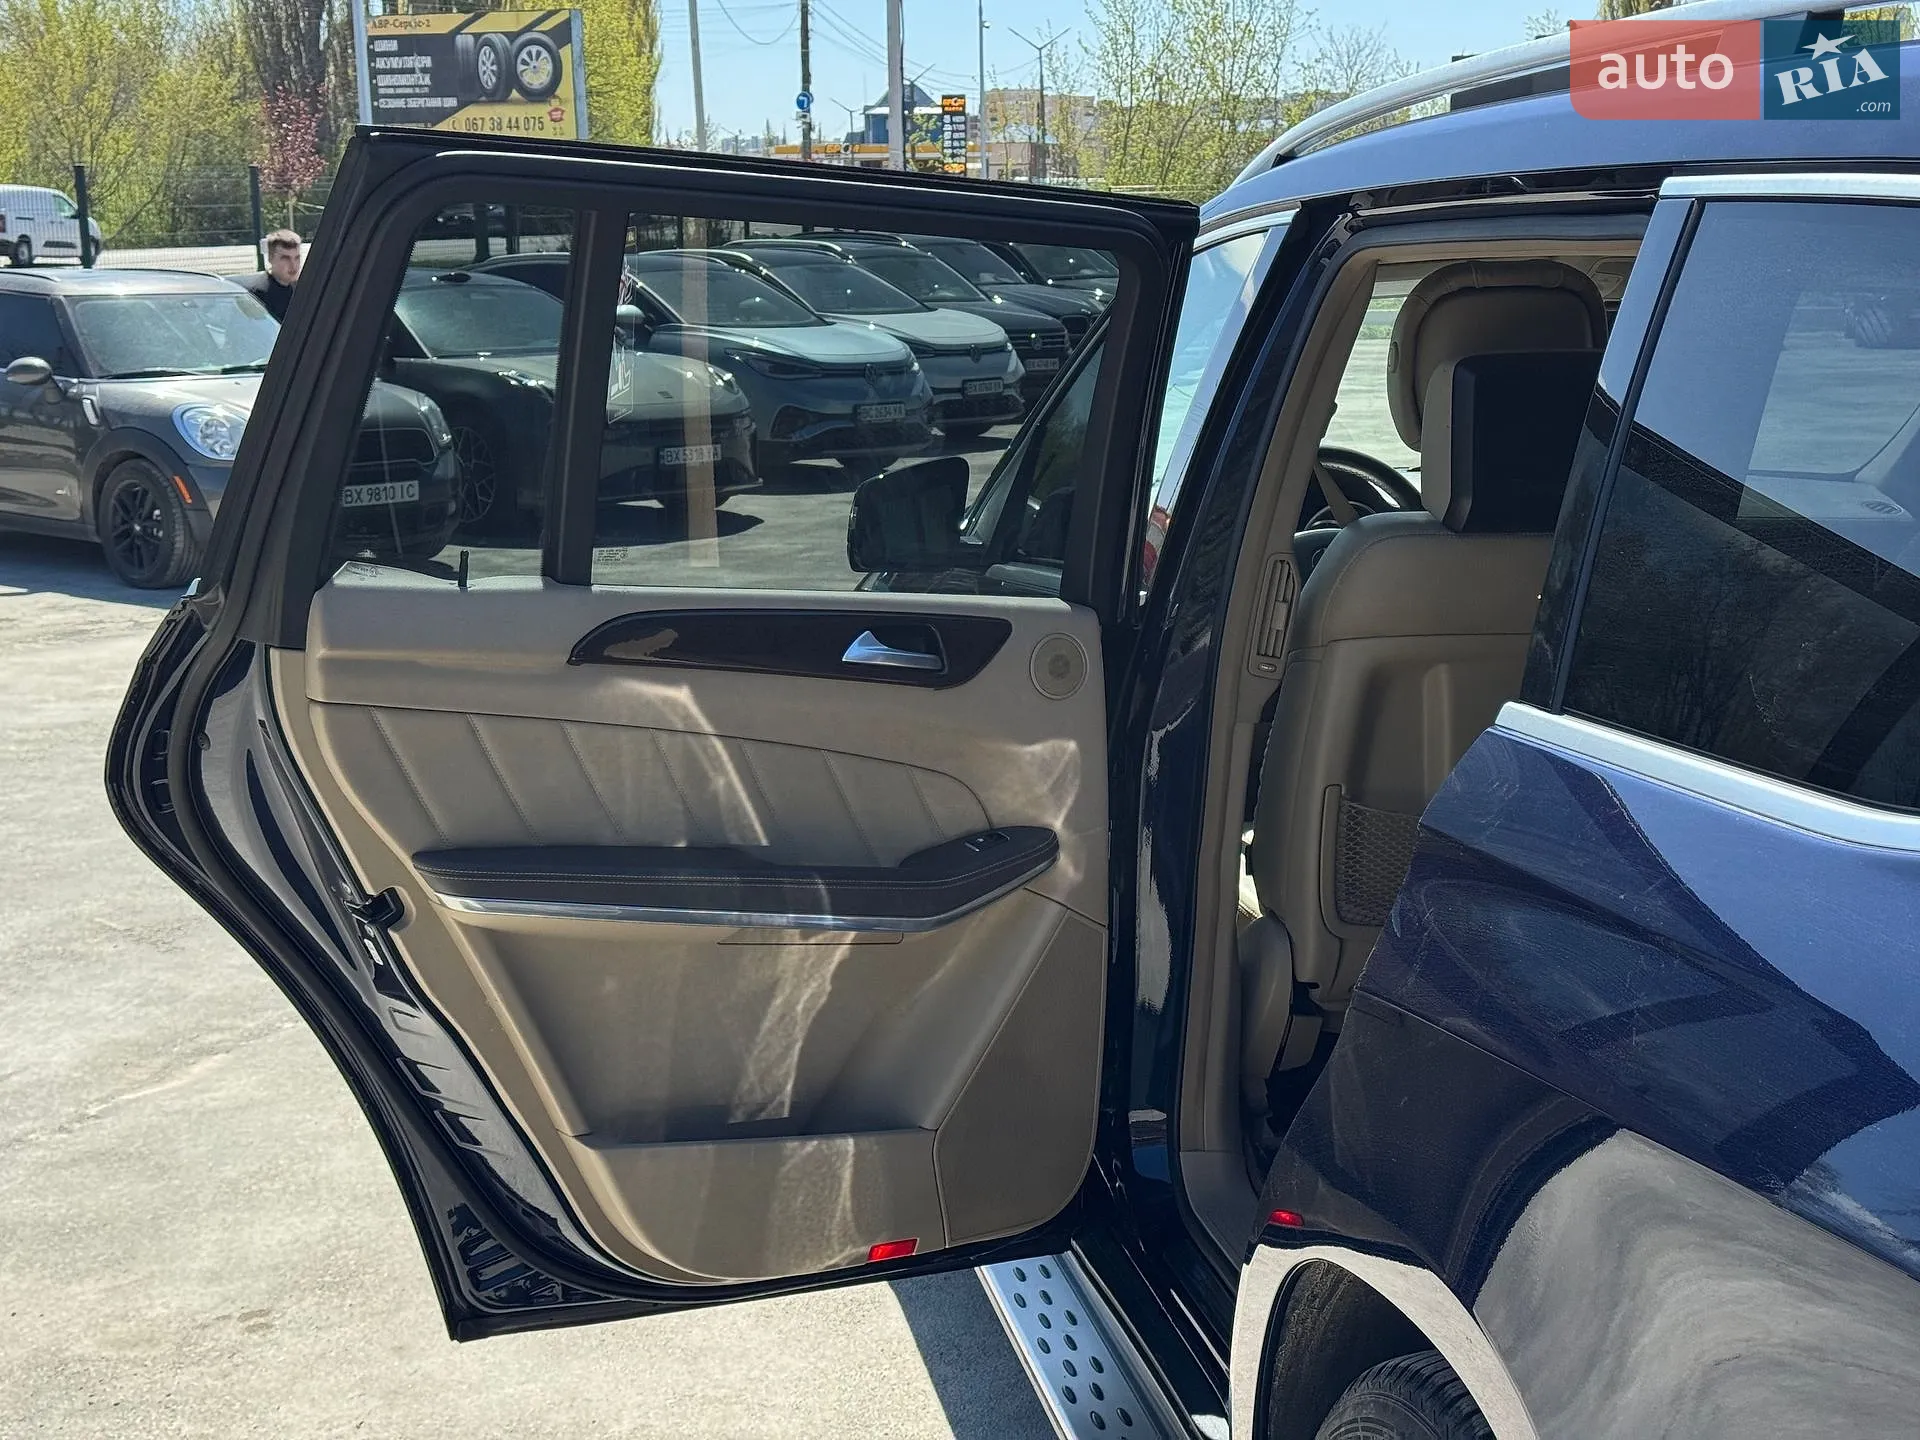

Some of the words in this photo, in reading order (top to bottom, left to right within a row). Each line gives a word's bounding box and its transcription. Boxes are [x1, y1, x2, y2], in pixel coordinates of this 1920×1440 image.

[464, 117, 485, 131] 067
[489, 117, 502, 131] 38
[506, 117, 520, 131] 44
[524, 116, 544, 131] 075
[344, 488, 363, 504] BX
[367, 486, 395, 503] 9810
[400, 484, 415, 499] IC
